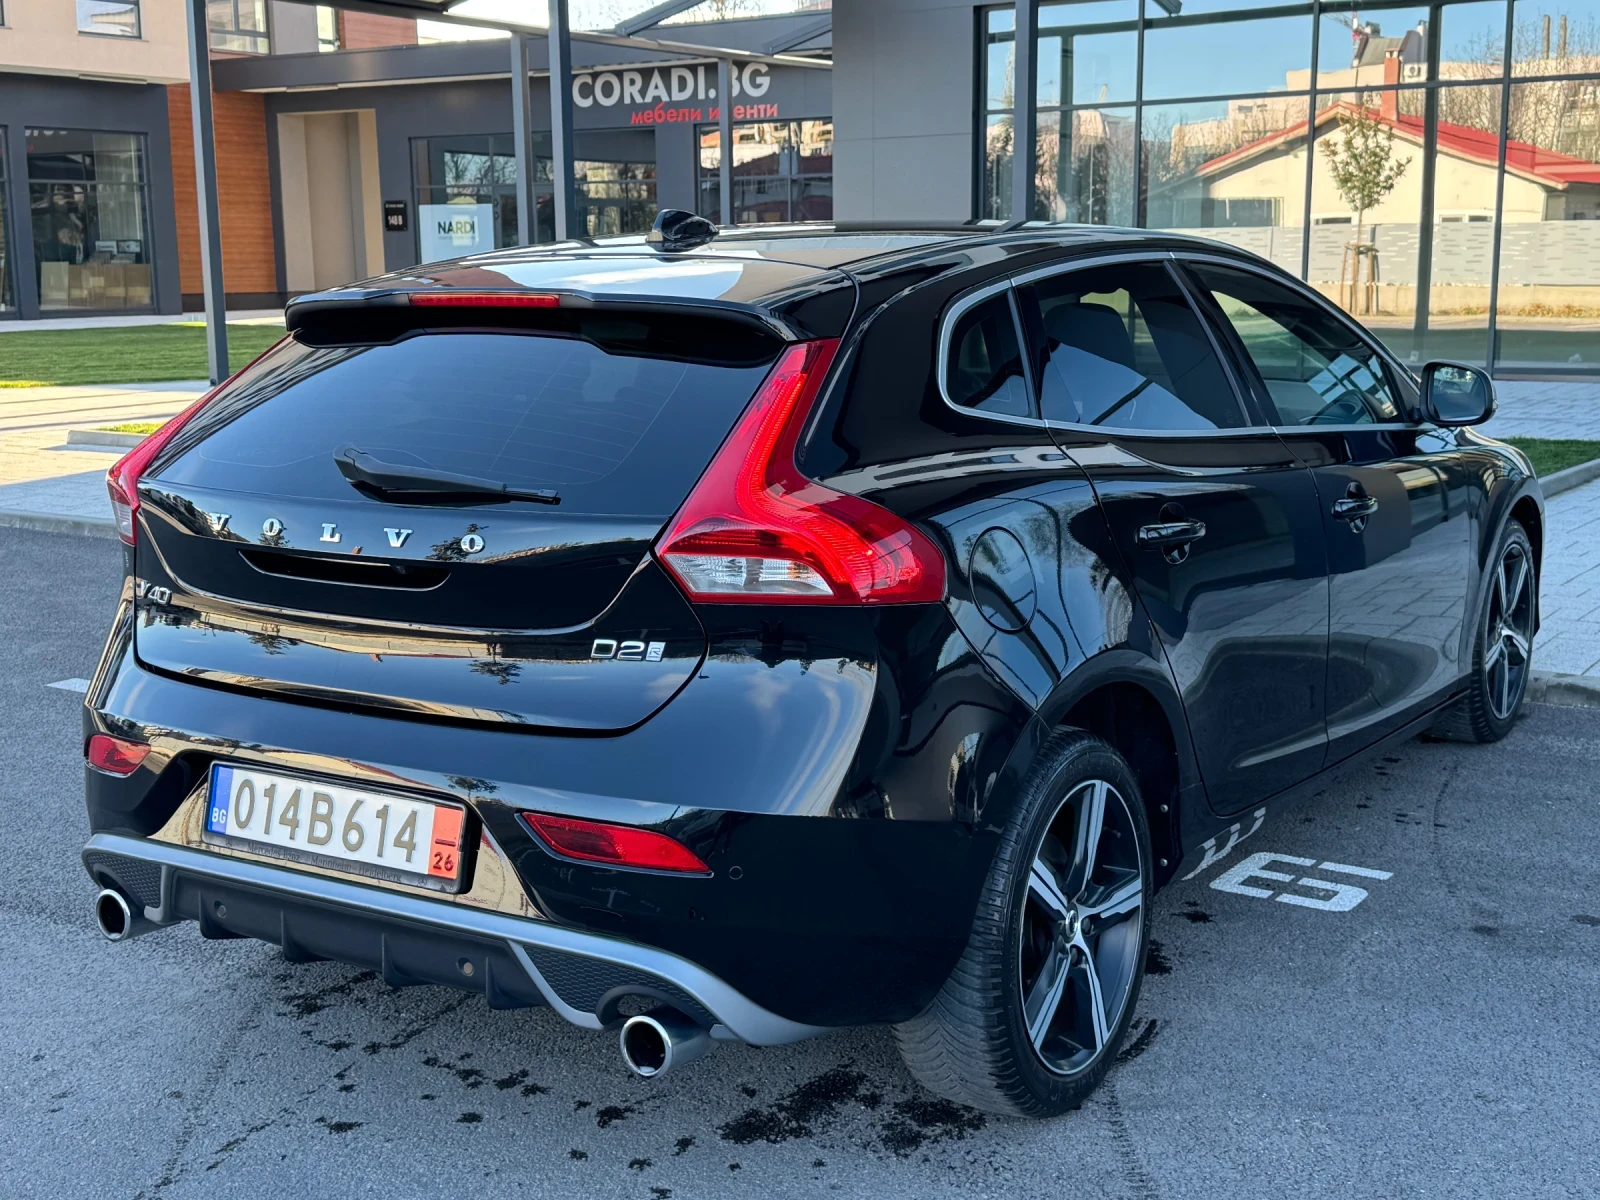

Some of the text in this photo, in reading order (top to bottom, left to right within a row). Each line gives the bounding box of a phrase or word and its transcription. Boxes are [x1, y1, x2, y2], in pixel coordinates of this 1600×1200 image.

[630, 102, 779, 125] мебели иенти
[437, 221, 476, 235] NARDI
[207, 511, 486, 554] VOLVO
[139, 579, 172, 606] V40
[590, 638, 646, 661] D2
[212, 807, 227, 825] BG
[234, 778, 418, 864] 014B614
[432, 850, 455, 873] 26
